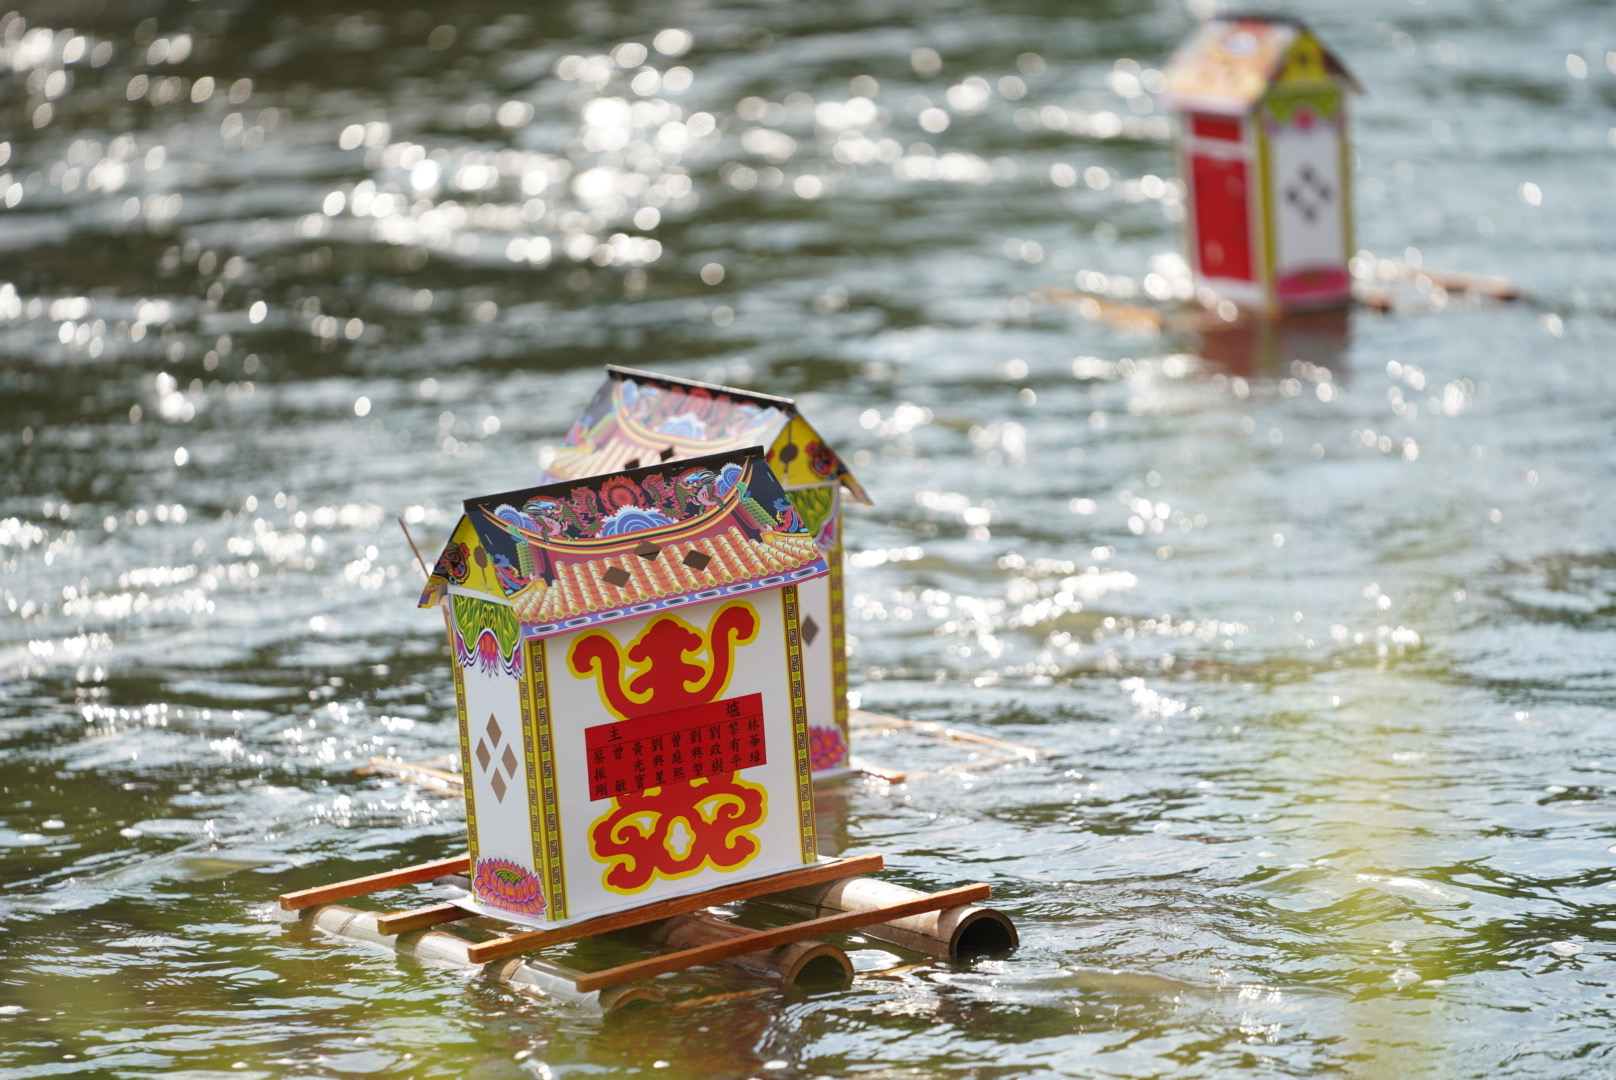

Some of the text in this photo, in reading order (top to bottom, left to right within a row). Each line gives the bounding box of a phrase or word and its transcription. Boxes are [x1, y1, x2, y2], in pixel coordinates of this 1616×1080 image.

[607, 700, 743, 743] 爐 主
[727, 721, 743, 768] 黎有平
[593, 748, 609, 796] 蔡振剛
[650, 736, 667, 786] 劉興星
[708, 724, 724, 773] 劉政樹
